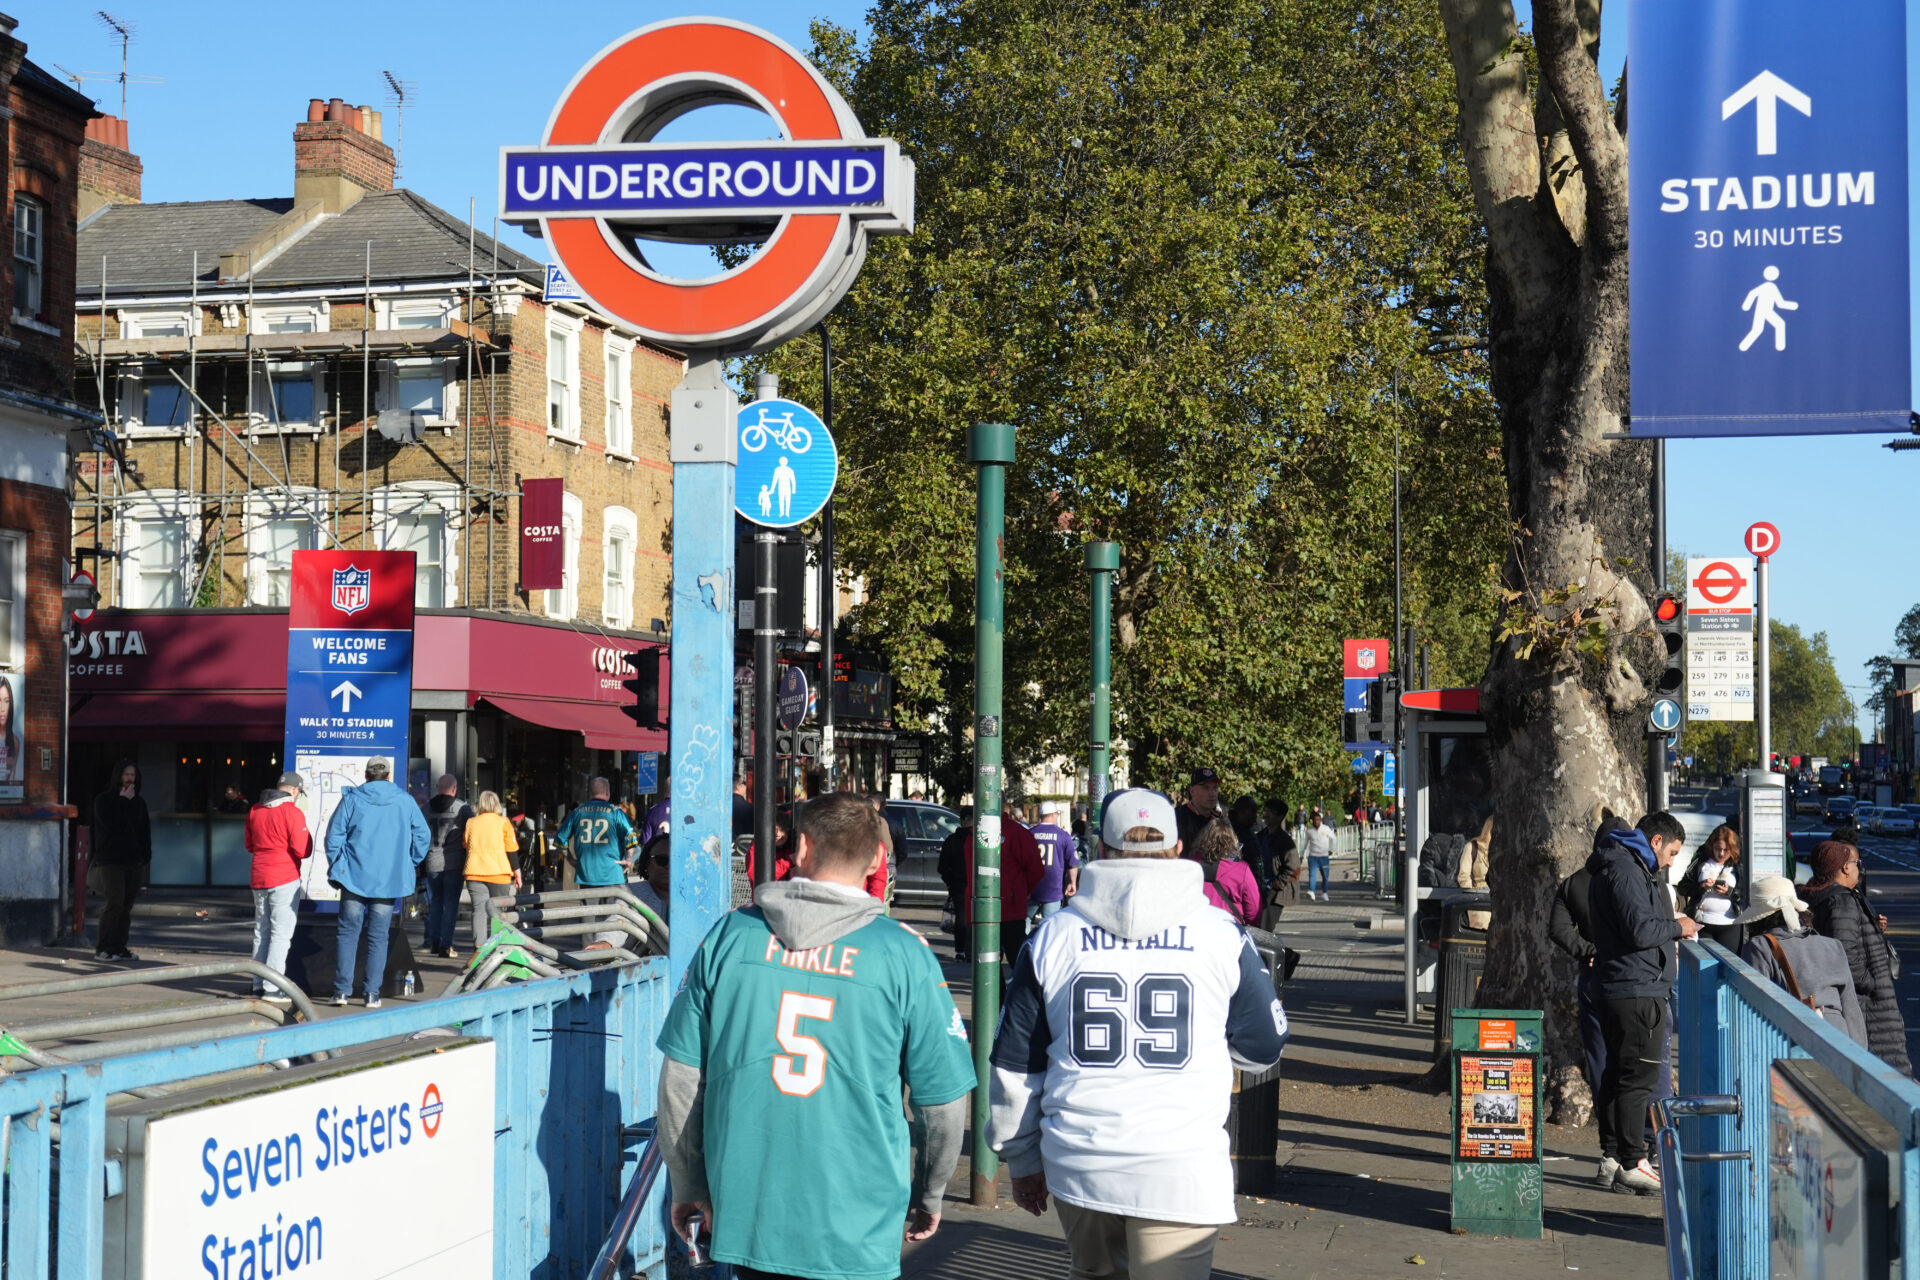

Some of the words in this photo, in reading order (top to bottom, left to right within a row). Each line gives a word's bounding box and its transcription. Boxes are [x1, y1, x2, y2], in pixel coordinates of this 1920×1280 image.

[516, 159, 877, 201] UNDERGROUND
[1660, 171, 1875, 213] STADIUM
[1694, 230, 1724, 248] 30
[1733, 225, 1843, 247] MINUTES
[524, 526, 561, 536] COSTA
[1751, 527, 1774, 552] D
[336, 586, 365, 607] NFL
[70, 630, 147, 659] OSTA
[312, 637, 387, 650] WELCOME
[328, 652, 368, 665] FANS
[600, 679, 621, 690] COFFEE
[781, 693, 805, 706] GAMEDAY
[785, 703, 801, 715] GUIDE
[300, 717, 328, 727] WALK
[331, 718, 344, 727] TO
[347, 718, 394, 728] STADIUM
[316, 731, 327, 739] 30
[329, 731, 367, 739] MINUTES
[579, 818, 610, 844] 32
[1068, 971, 1194, 1070] 69
[771, 990, 836, 1098] 5
[201, 1133, 302, 1207] Seven
[315, 1102, 411, 1171] Sisters
[202, 1211, 322, 1280] Station
